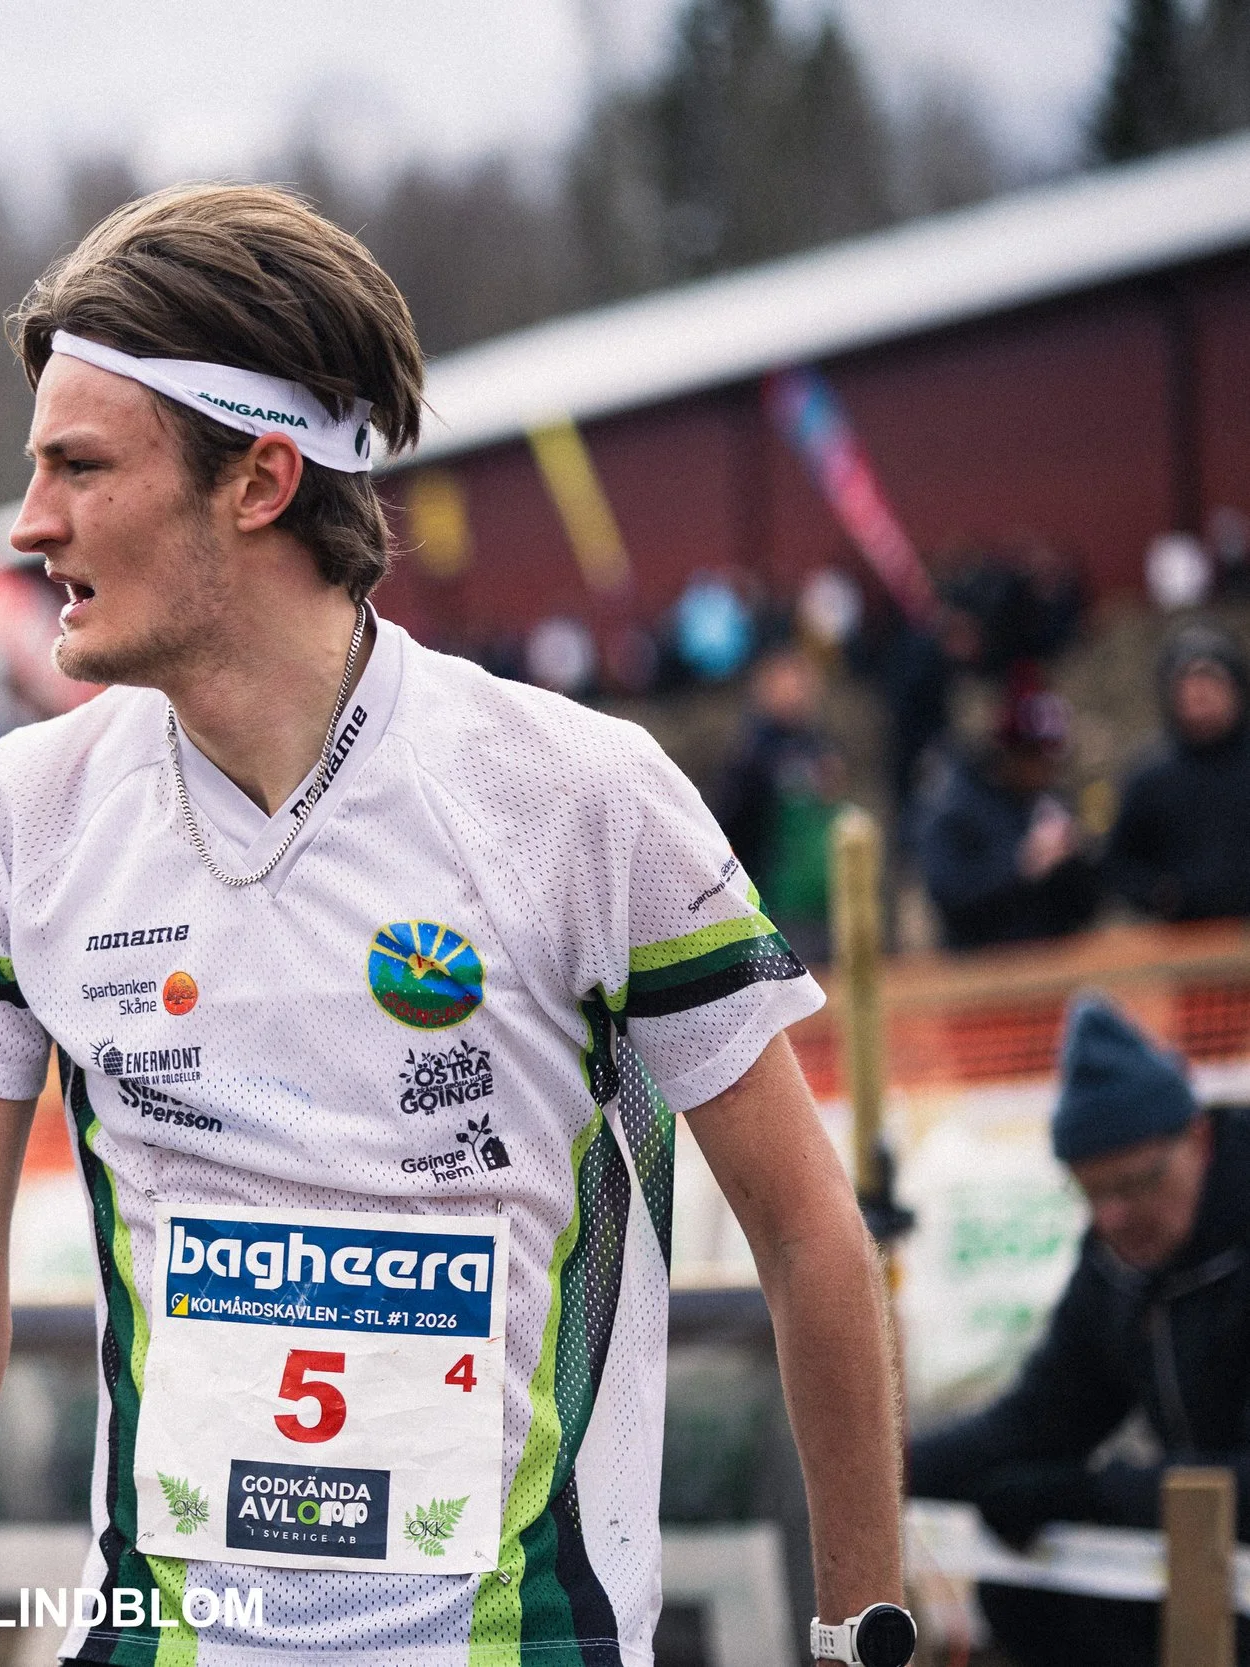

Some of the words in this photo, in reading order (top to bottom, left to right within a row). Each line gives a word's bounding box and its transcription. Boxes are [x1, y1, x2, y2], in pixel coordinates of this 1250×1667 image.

[86, 925, 190, 951] noname
[82, 979, 157, 1002] Sparbanken
[119, 997, 158, 1016] Skåne
[126, 1046, 202, 1074] ENERMONT
[415, 1056, 492, 1087] ÖSTRA
[400, 1079, 494, 1116] GÖINGE
[141, 1100, 223, 1133] persson
[401, 1149, 466, 1174] Göinge
[434, 1164, 474, 1184] hem
[170, 1225, 490, 1292] bagheera
[191, 1295, 337, 1322] KOLMÅRDSKAVLEN
[354, 1309, 384, 1326] STL
[387, 1312, 409, 1327] #1
[415, 1313, 458, 1329] 2026
[444, 1353, 478, 1393] 4
[273, 1349, 348, 1444] 5
[241, 1475, 372, 1501] GODKÄNDA
[263, 1529, 328, 1543] SVERIGE
[337, 1536, 357, 1544] AB
[409, 1520, 448, 1537] OKK
